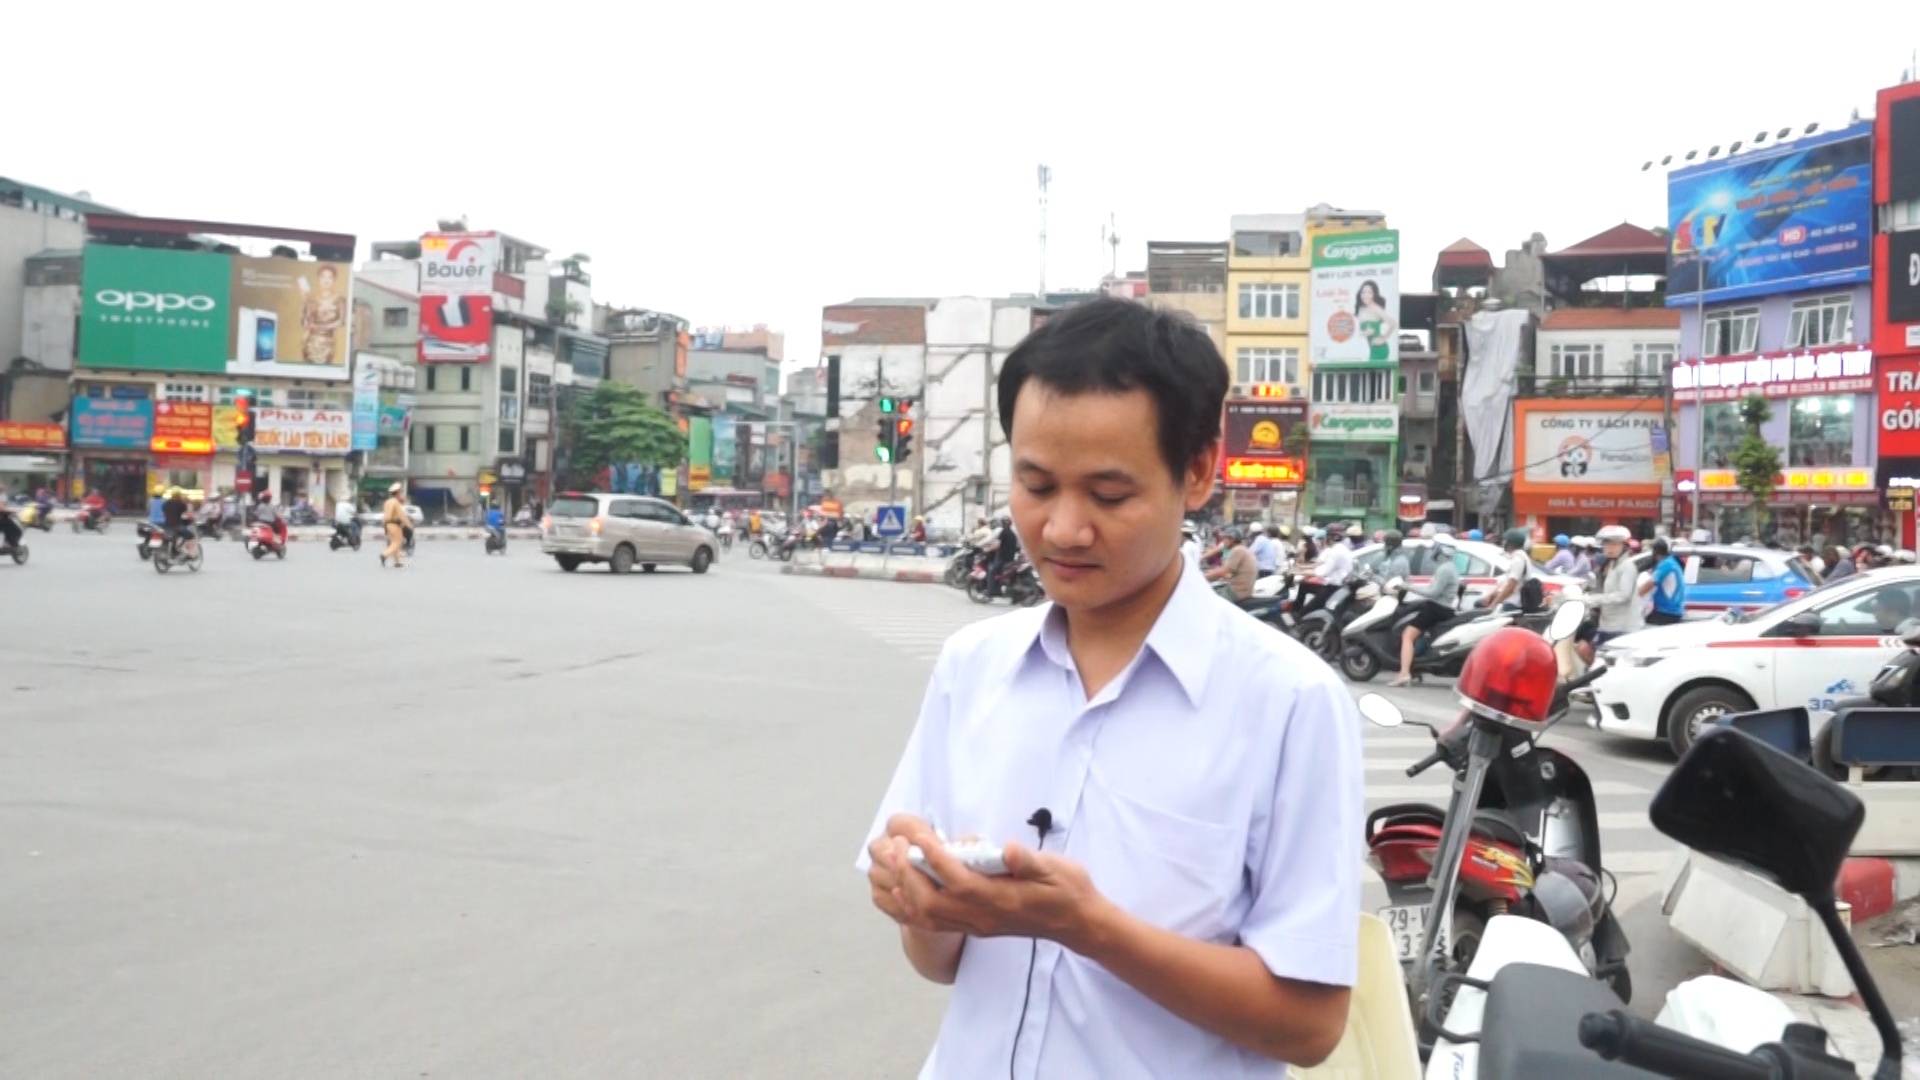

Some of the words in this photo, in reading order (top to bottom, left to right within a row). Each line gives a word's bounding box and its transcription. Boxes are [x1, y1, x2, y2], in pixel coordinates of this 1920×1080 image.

[427, 261, 485, 278] Bauer
[1541, 416, 1576, 429] CÔNG
[1579, 418, 1593, 429] TY
[1597, 414, 1631, 429] SÁCH
